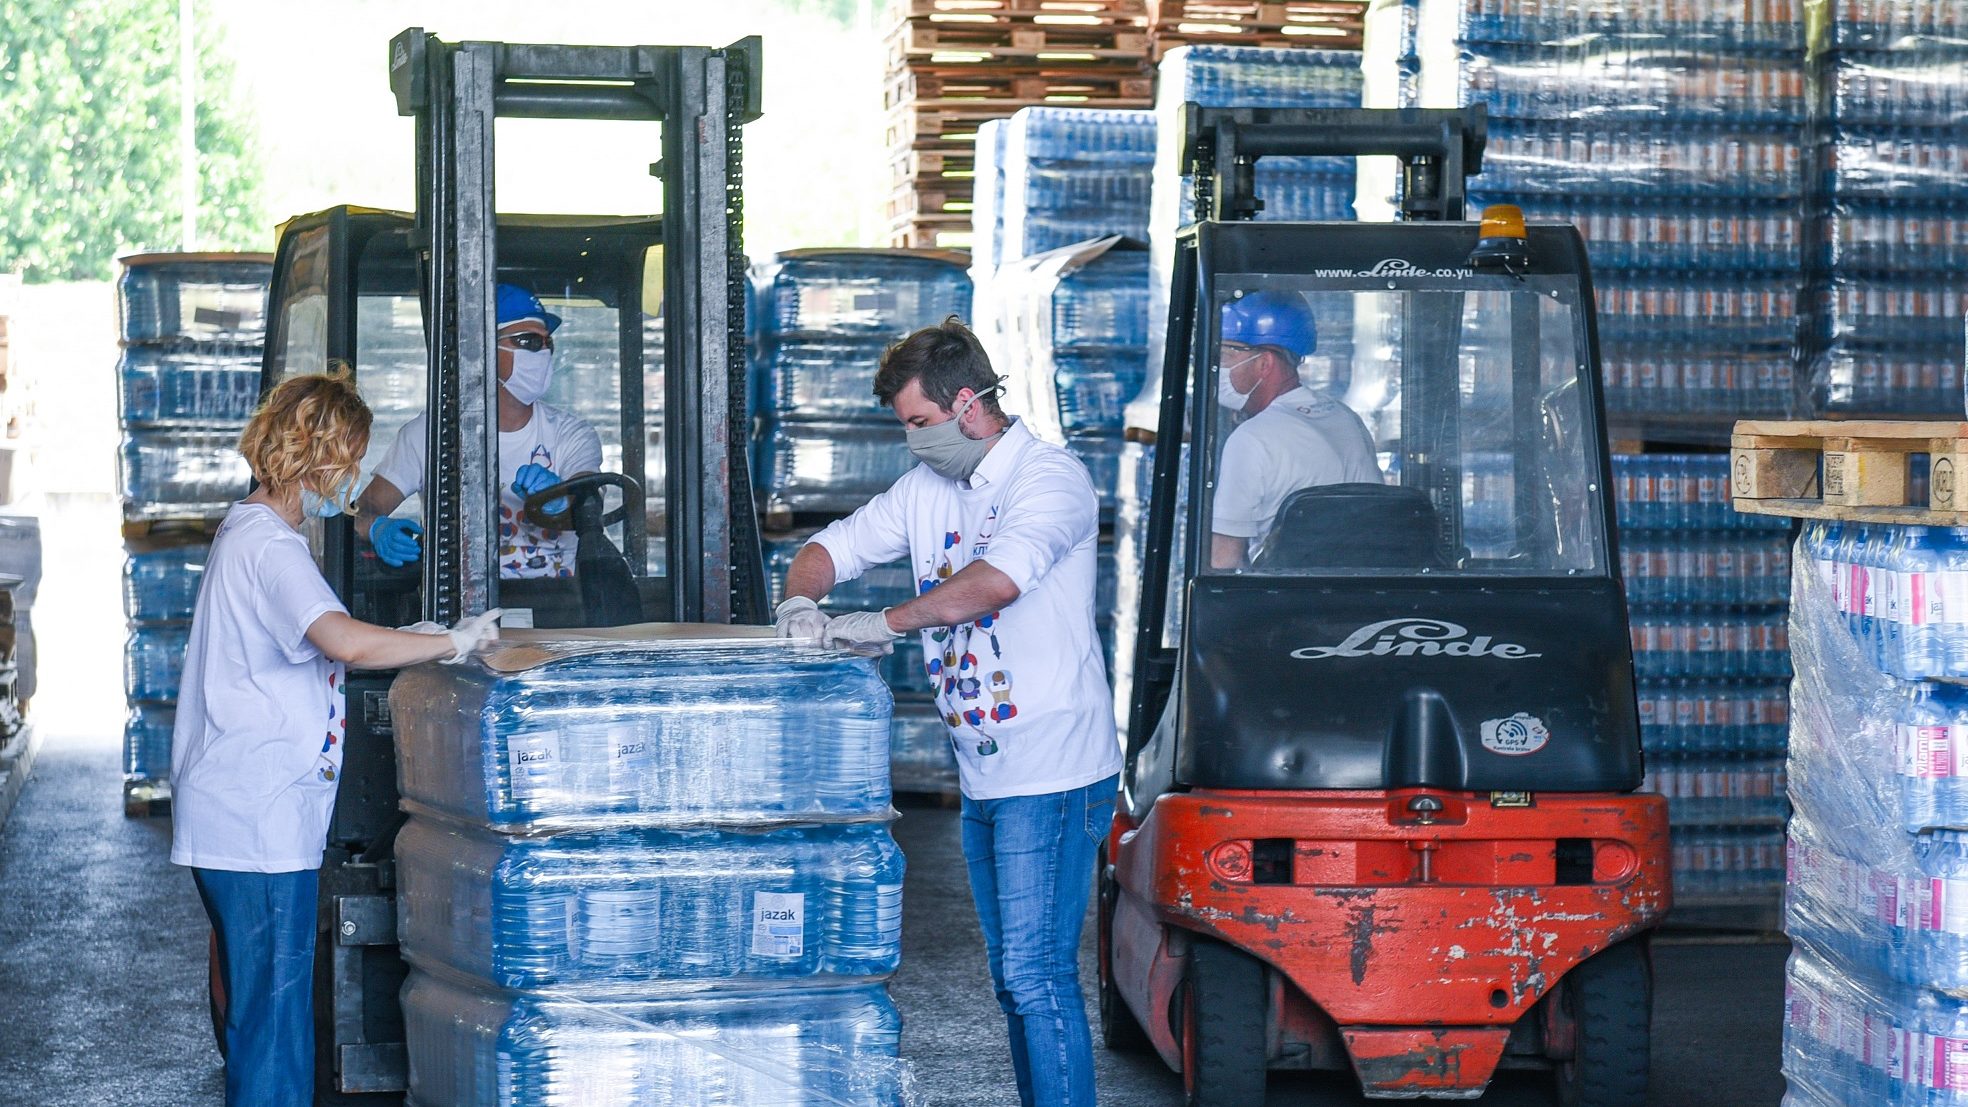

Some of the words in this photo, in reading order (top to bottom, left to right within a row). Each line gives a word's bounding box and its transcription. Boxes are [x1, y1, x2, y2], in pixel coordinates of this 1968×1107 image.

[1315, 258, 1473, 280] www.Linde.co.yu
[1290, 618, 1542, 659] Linde
[517, 748, 552, 765] jazak
[617, 742, 647, 758] jazak
[761, 907, 795, 922] jazak
